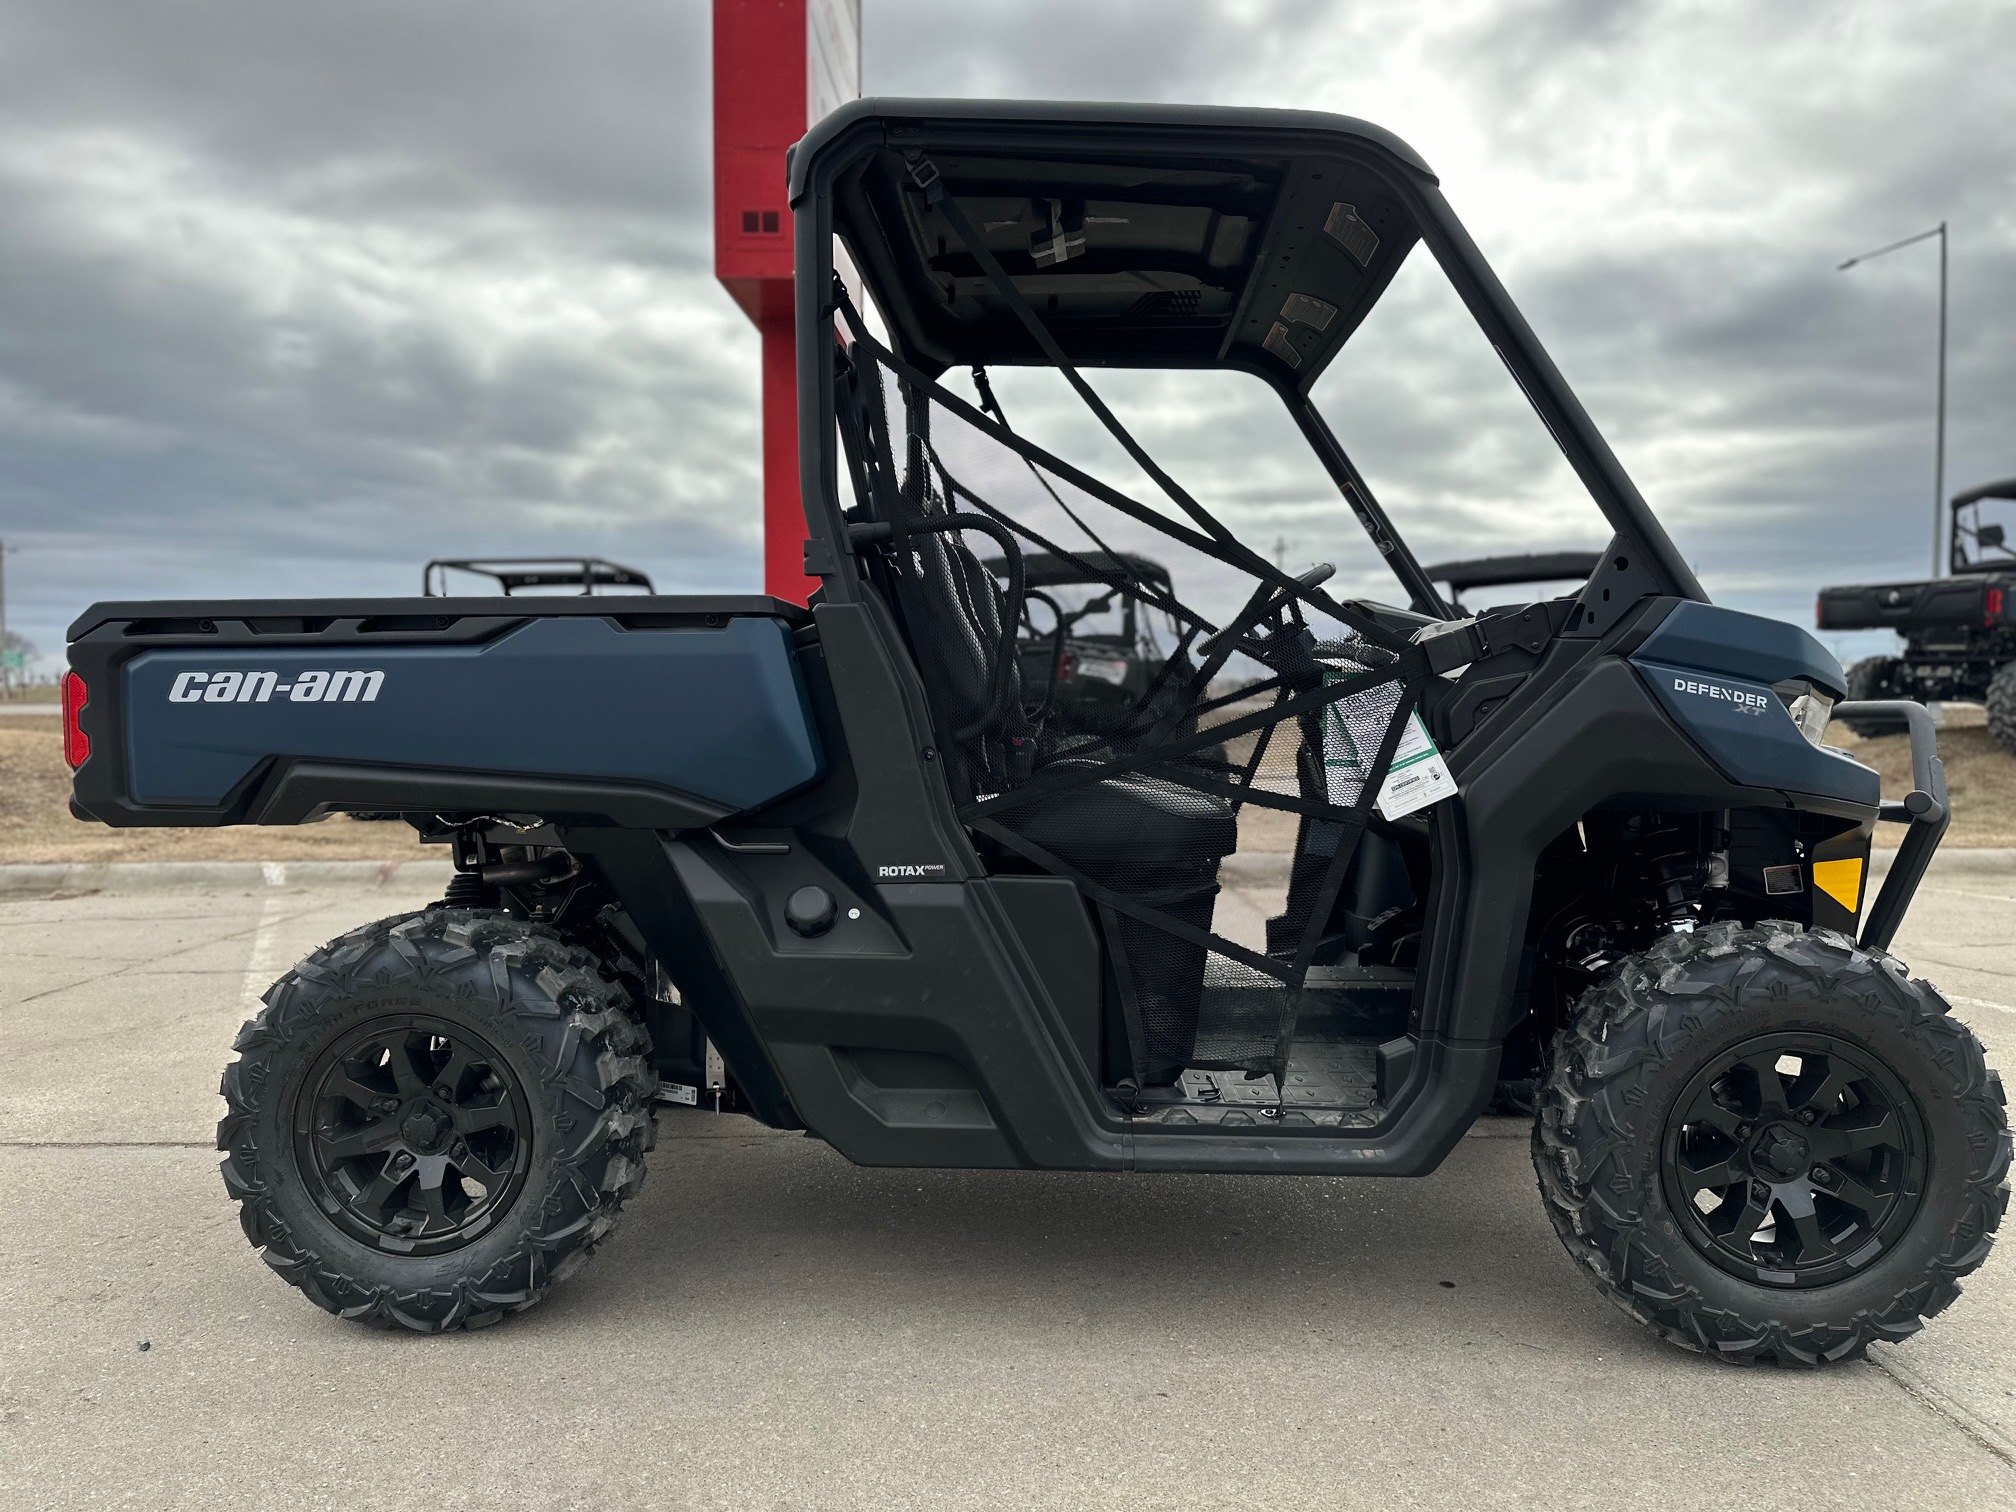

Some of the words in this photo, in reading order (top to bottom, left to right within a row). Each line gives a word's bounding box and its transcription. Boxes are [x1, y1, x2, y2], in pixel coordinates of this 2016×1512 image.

[168, 671, 386, 703] can-am
[1674, 679, 1768, 708] DEFENDER
[1733, 704, 1767, 716] XT
[879, 865, 926, 877] ROTAX
